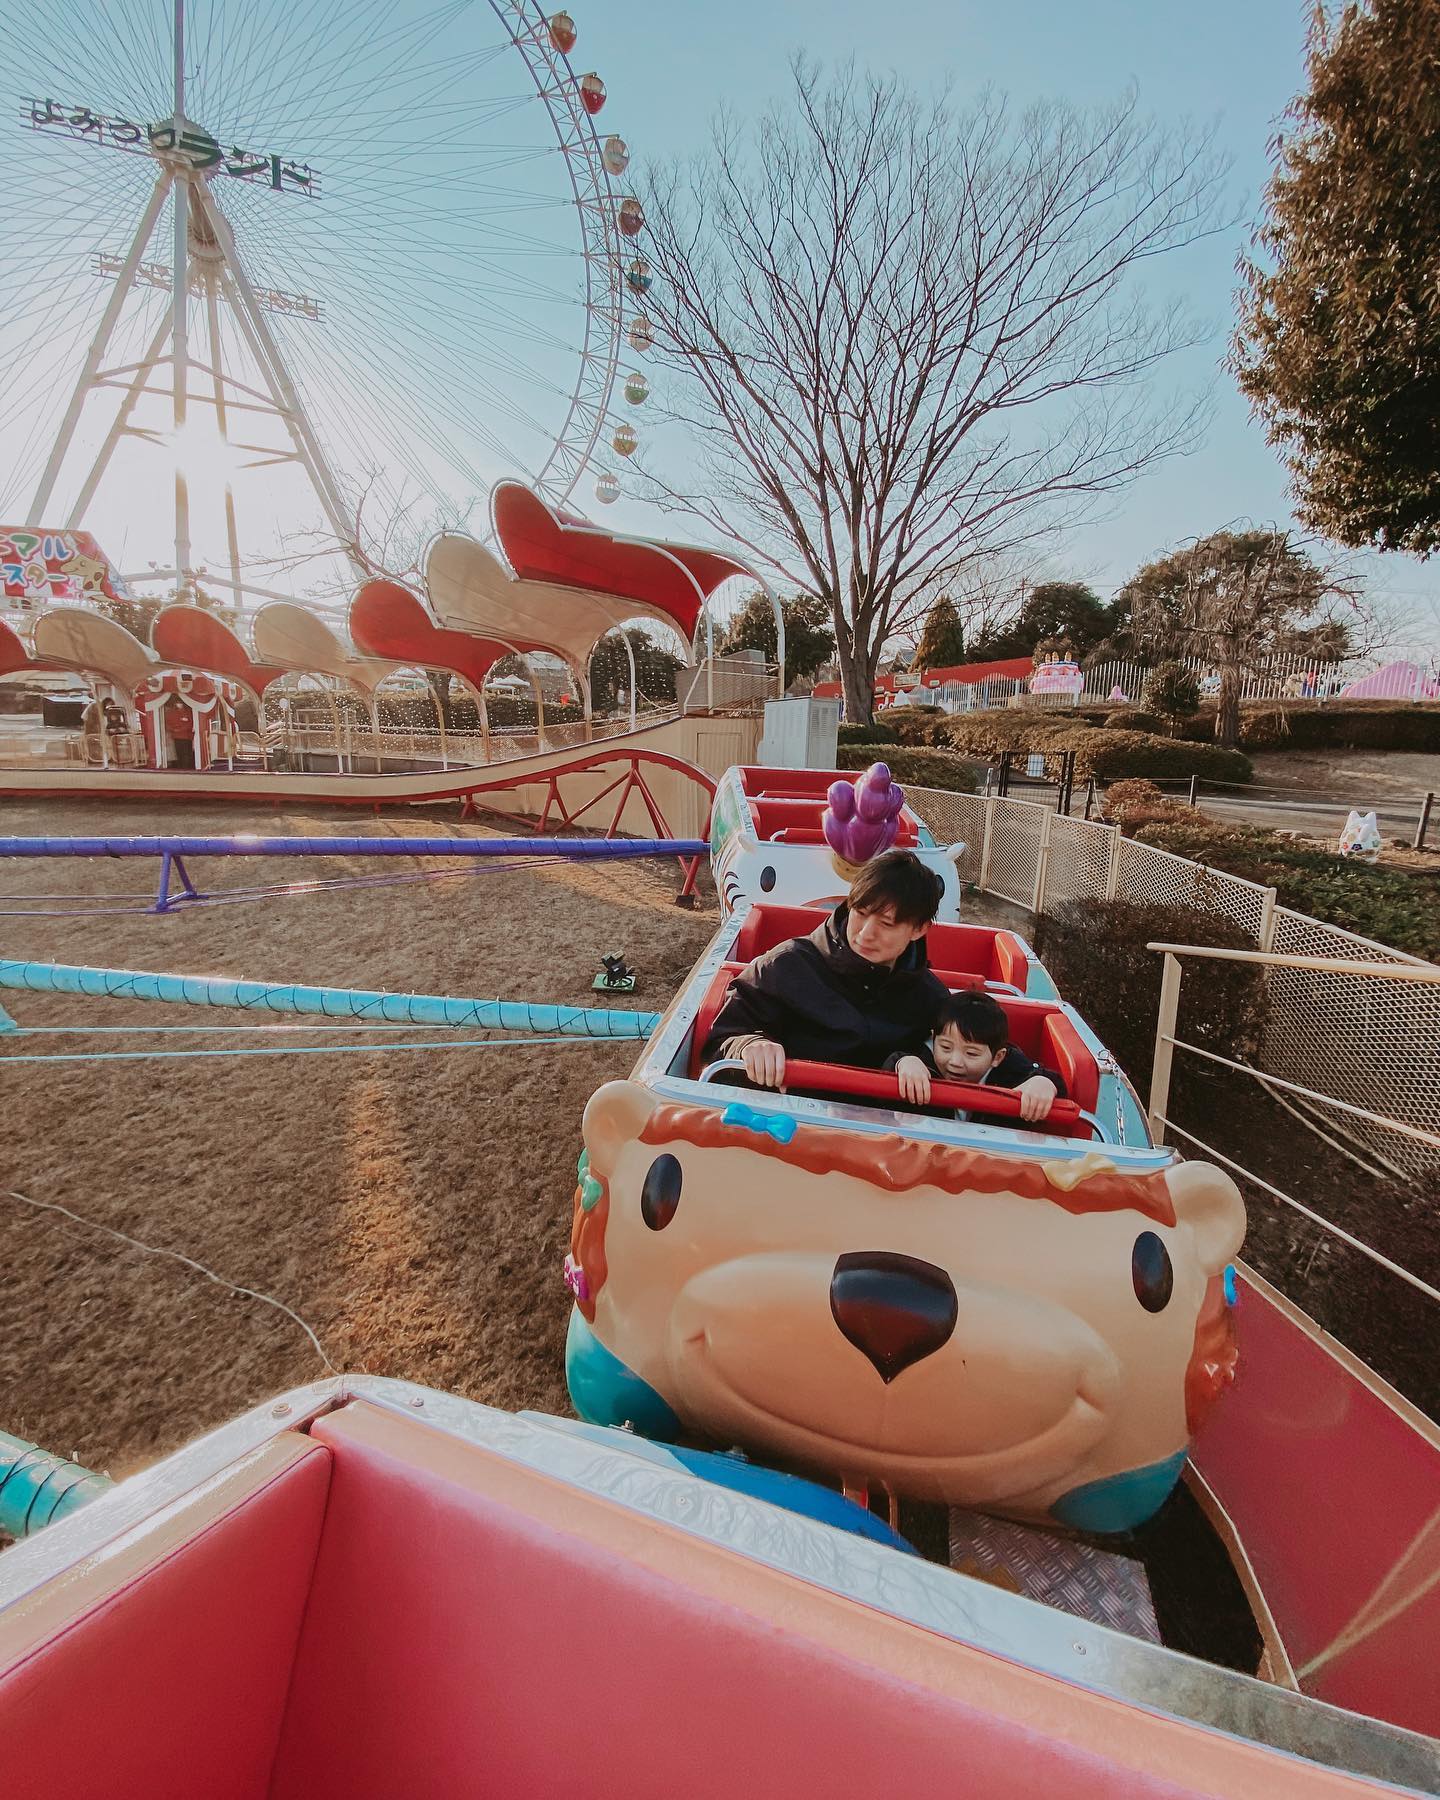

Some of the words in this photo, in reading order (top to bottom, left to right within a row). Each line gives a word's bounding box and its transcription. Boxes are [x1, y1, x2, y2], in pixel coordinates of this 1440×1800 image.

[31, 98, 312, 191] よみうりランド
[0, 533, 75, 560] マル
